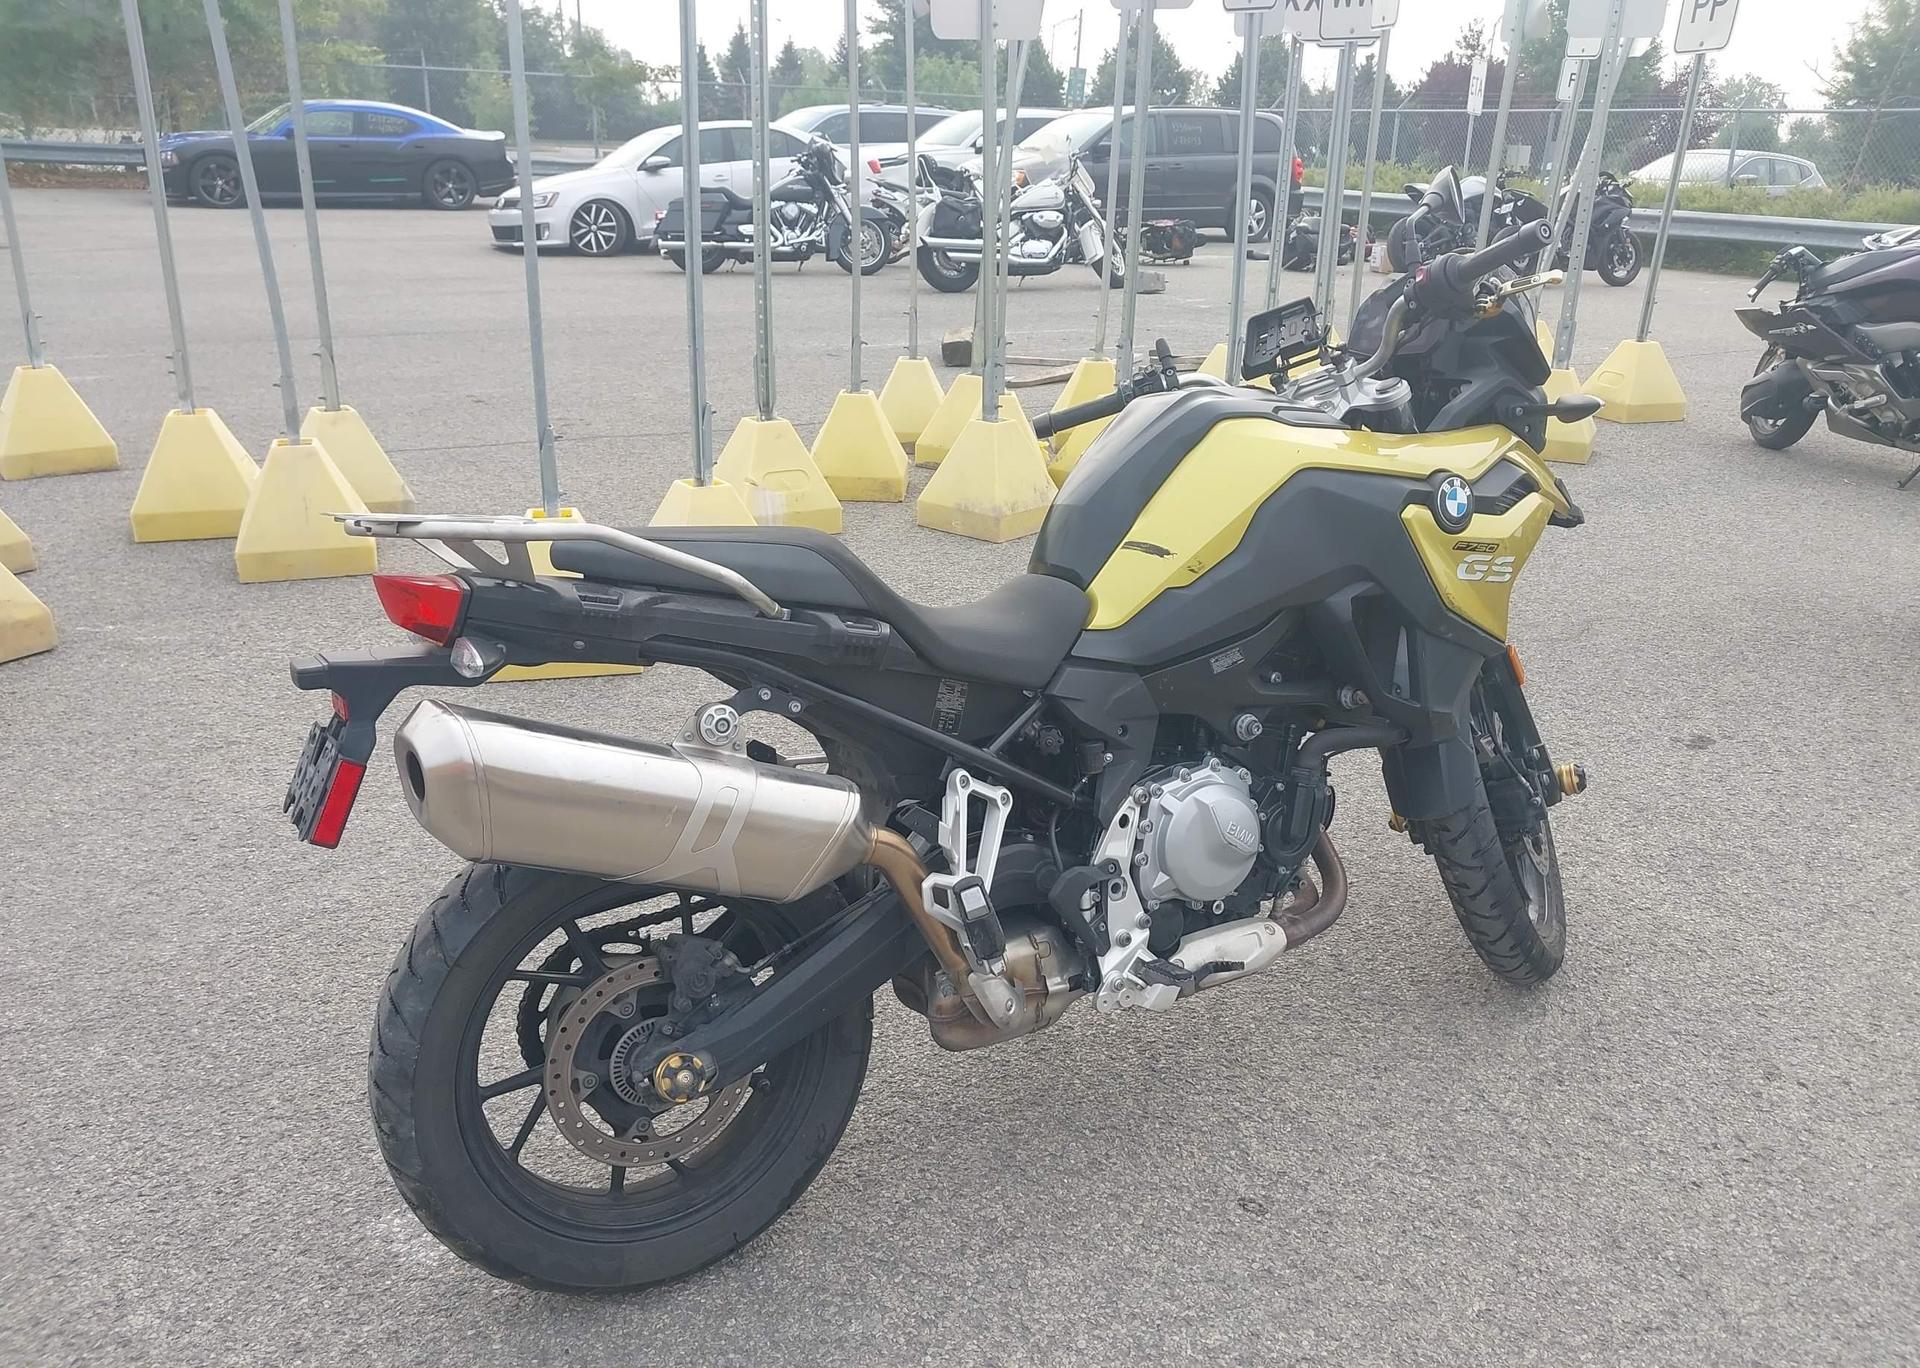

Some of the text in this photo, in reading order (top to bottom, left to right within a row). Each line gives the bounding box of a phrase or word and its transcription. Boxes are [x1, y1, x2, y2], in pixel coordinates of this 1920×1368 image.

[1442, 478, 1471, 496] BMW
[1454, 542, 1498, 553] F750
[1457, 554, 1516, 582] GS
[1227, 821, 1256, 846] BMW
